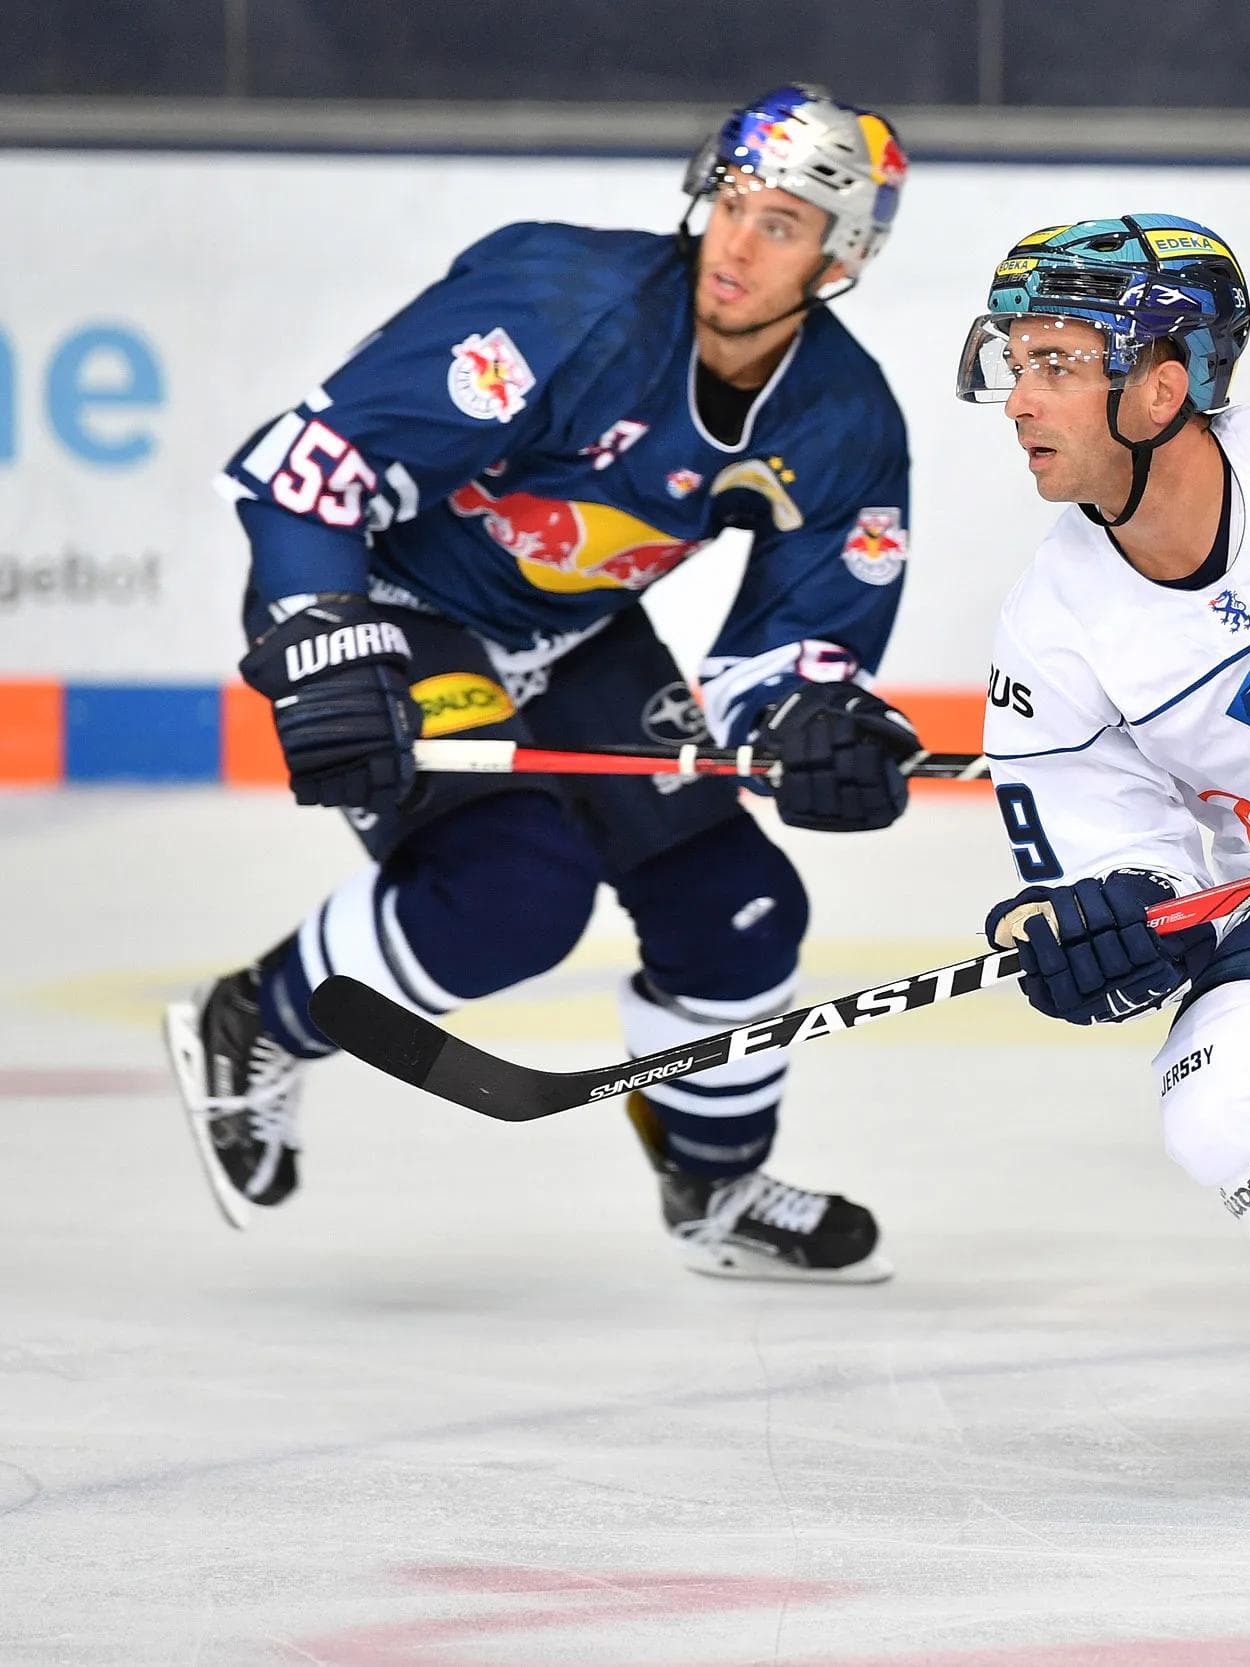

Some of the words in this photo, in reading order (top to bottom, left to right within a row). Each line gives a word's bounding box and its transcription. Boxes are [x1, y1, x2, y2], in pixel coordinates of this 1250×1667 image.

[1157, 237, 1214, 251] EDEKA
[0, 318, 167, 470] e
[272, 418, 378, 528] 55
[590, 1056, 694, 1102] SYNERGY
